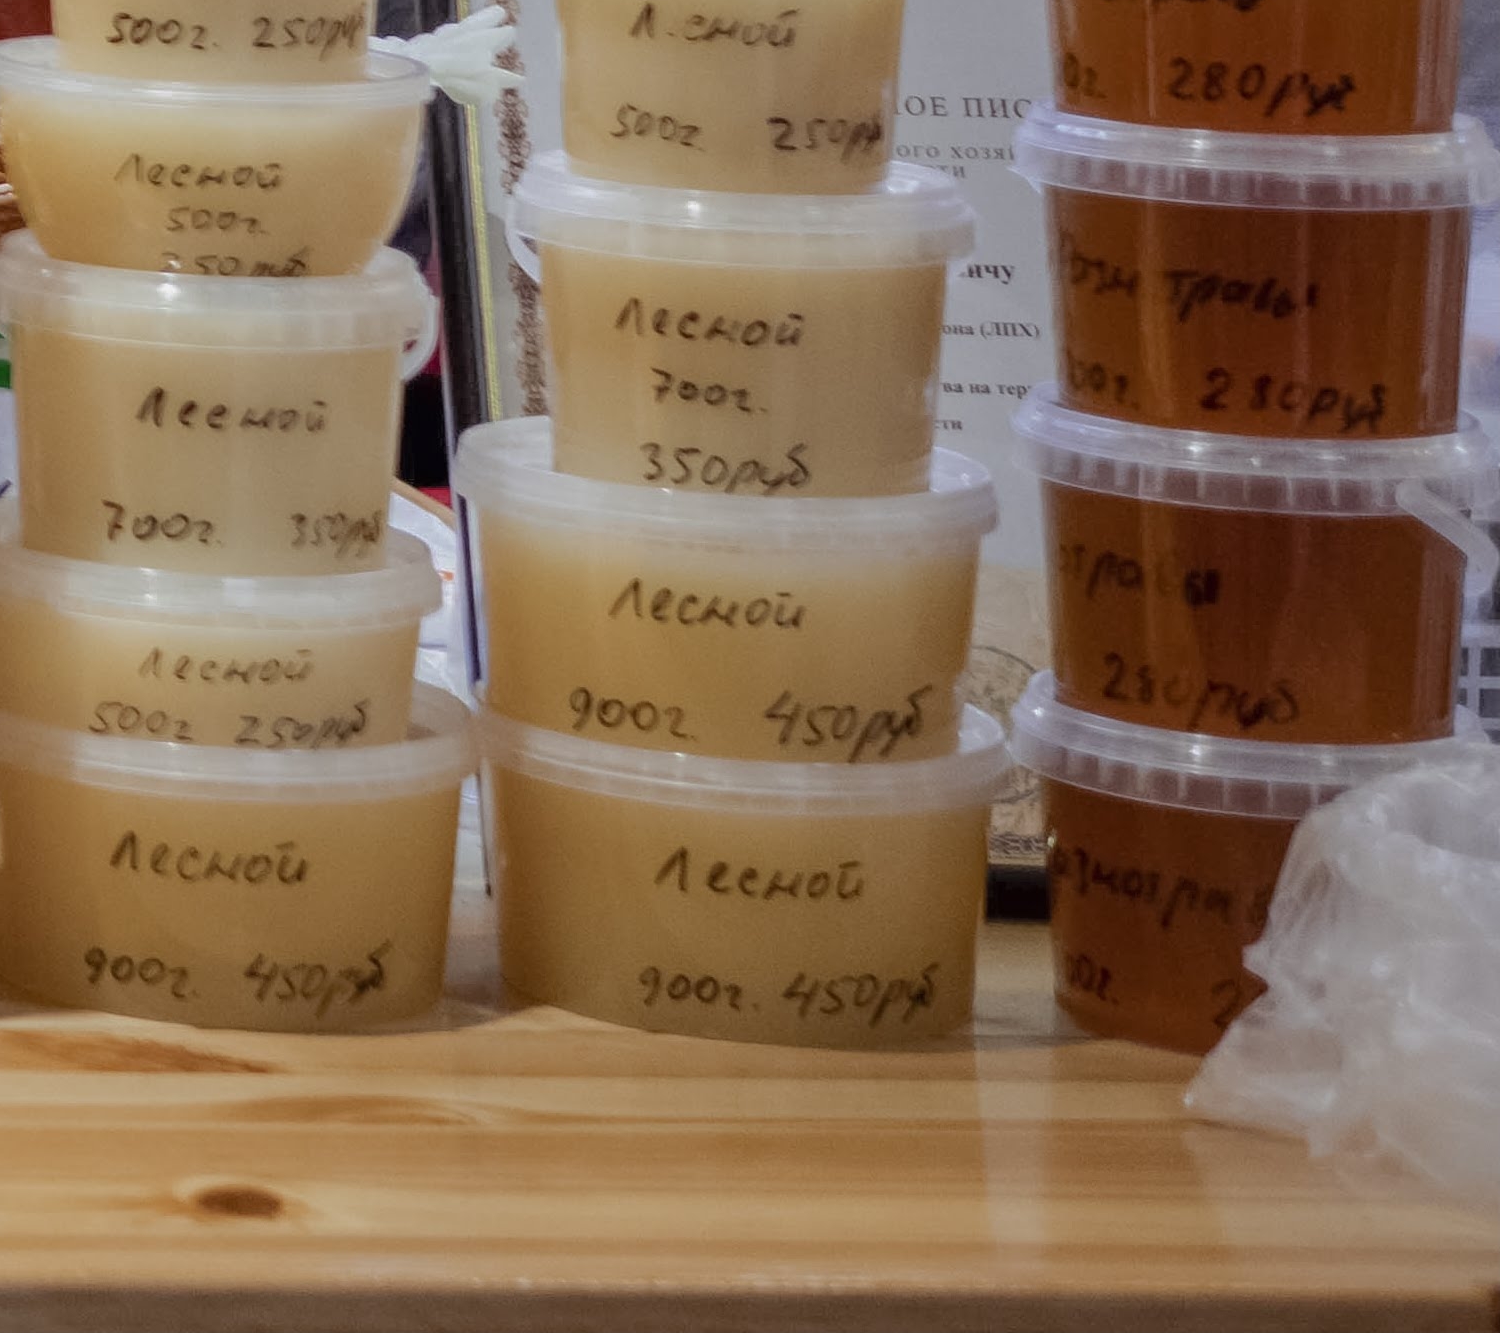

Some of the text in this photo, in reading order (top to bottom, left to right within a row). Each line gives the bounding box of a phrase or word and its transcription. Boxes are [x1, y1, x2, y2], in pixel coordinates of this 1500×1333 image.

[628, 0, 800, 48] Лсной
[114, 152, 286, 191] Лесной
[615, 296, 807, 348] Лесной
[134, 386, 330, 434] Лесной
[638, 440, 813, 498] 350руб
[608, 576, 807, 630] Лесной
[137, 645, 316, 686] Лесной
[763, 682, 933, 765] 450руб
[108, 830, 310, 887] Лесной
[653, 844, 866, 902] Лесной
[242, 942, 392, 1018] 450руб
[781, 962, 941, 1029] 450руб
